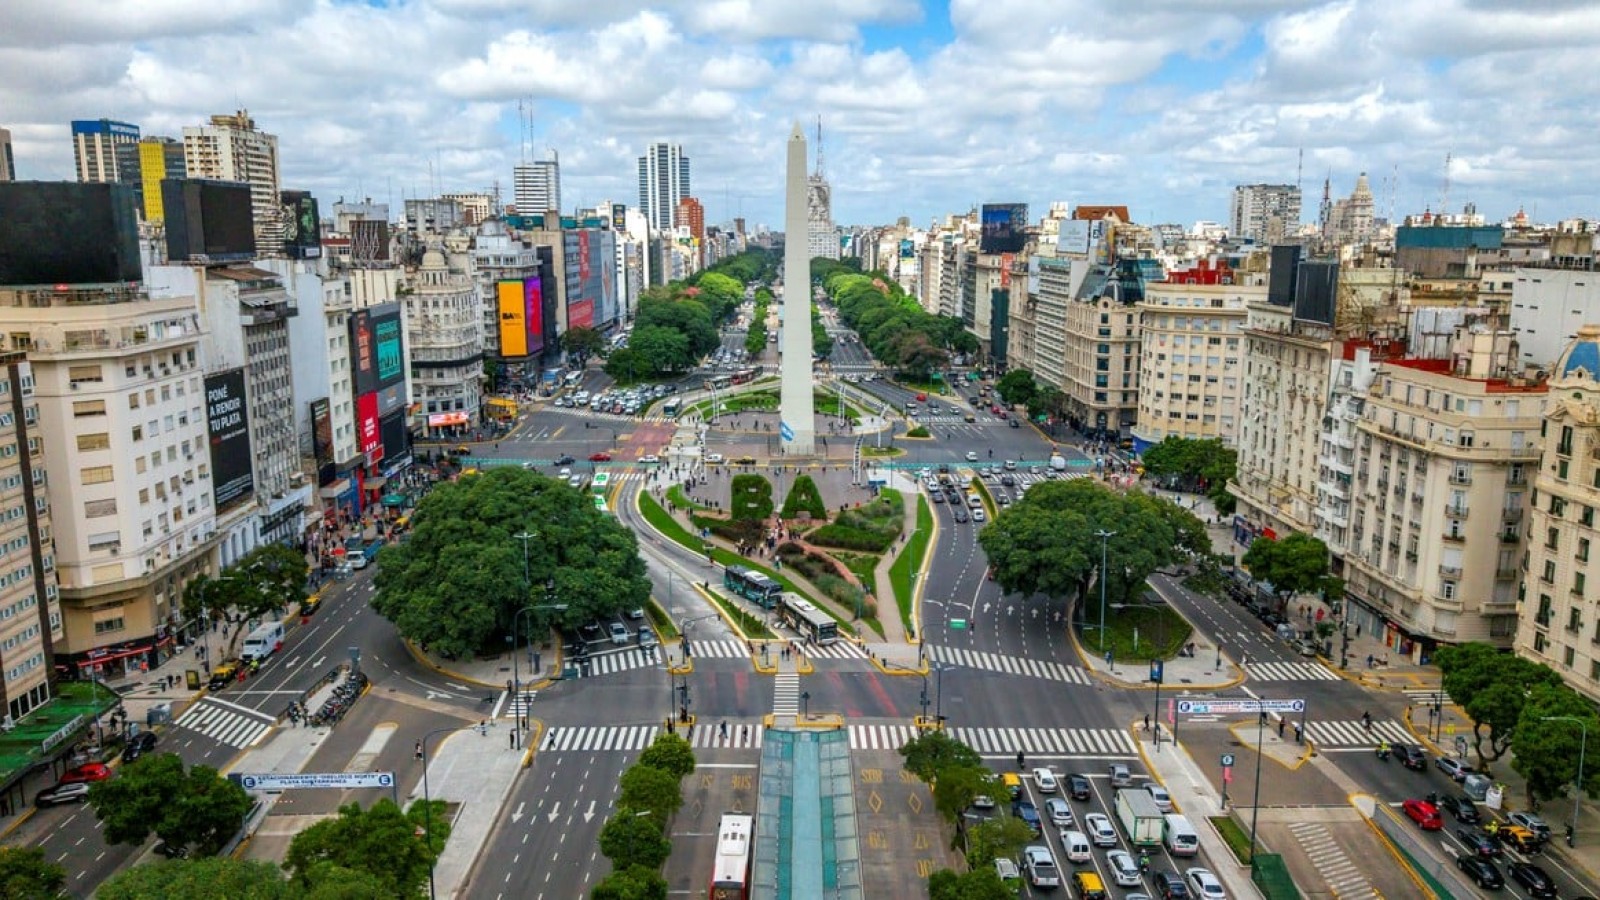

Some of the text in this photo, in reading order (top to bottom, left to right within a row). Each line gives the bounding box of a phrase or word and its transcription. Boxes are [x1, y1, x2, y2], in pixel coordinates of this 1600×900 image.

[208, 384, 228, 403] PONÉ
[210, 397, 240, 418] A RENDIR
[210, 412, 241, 432] TU PLATA
